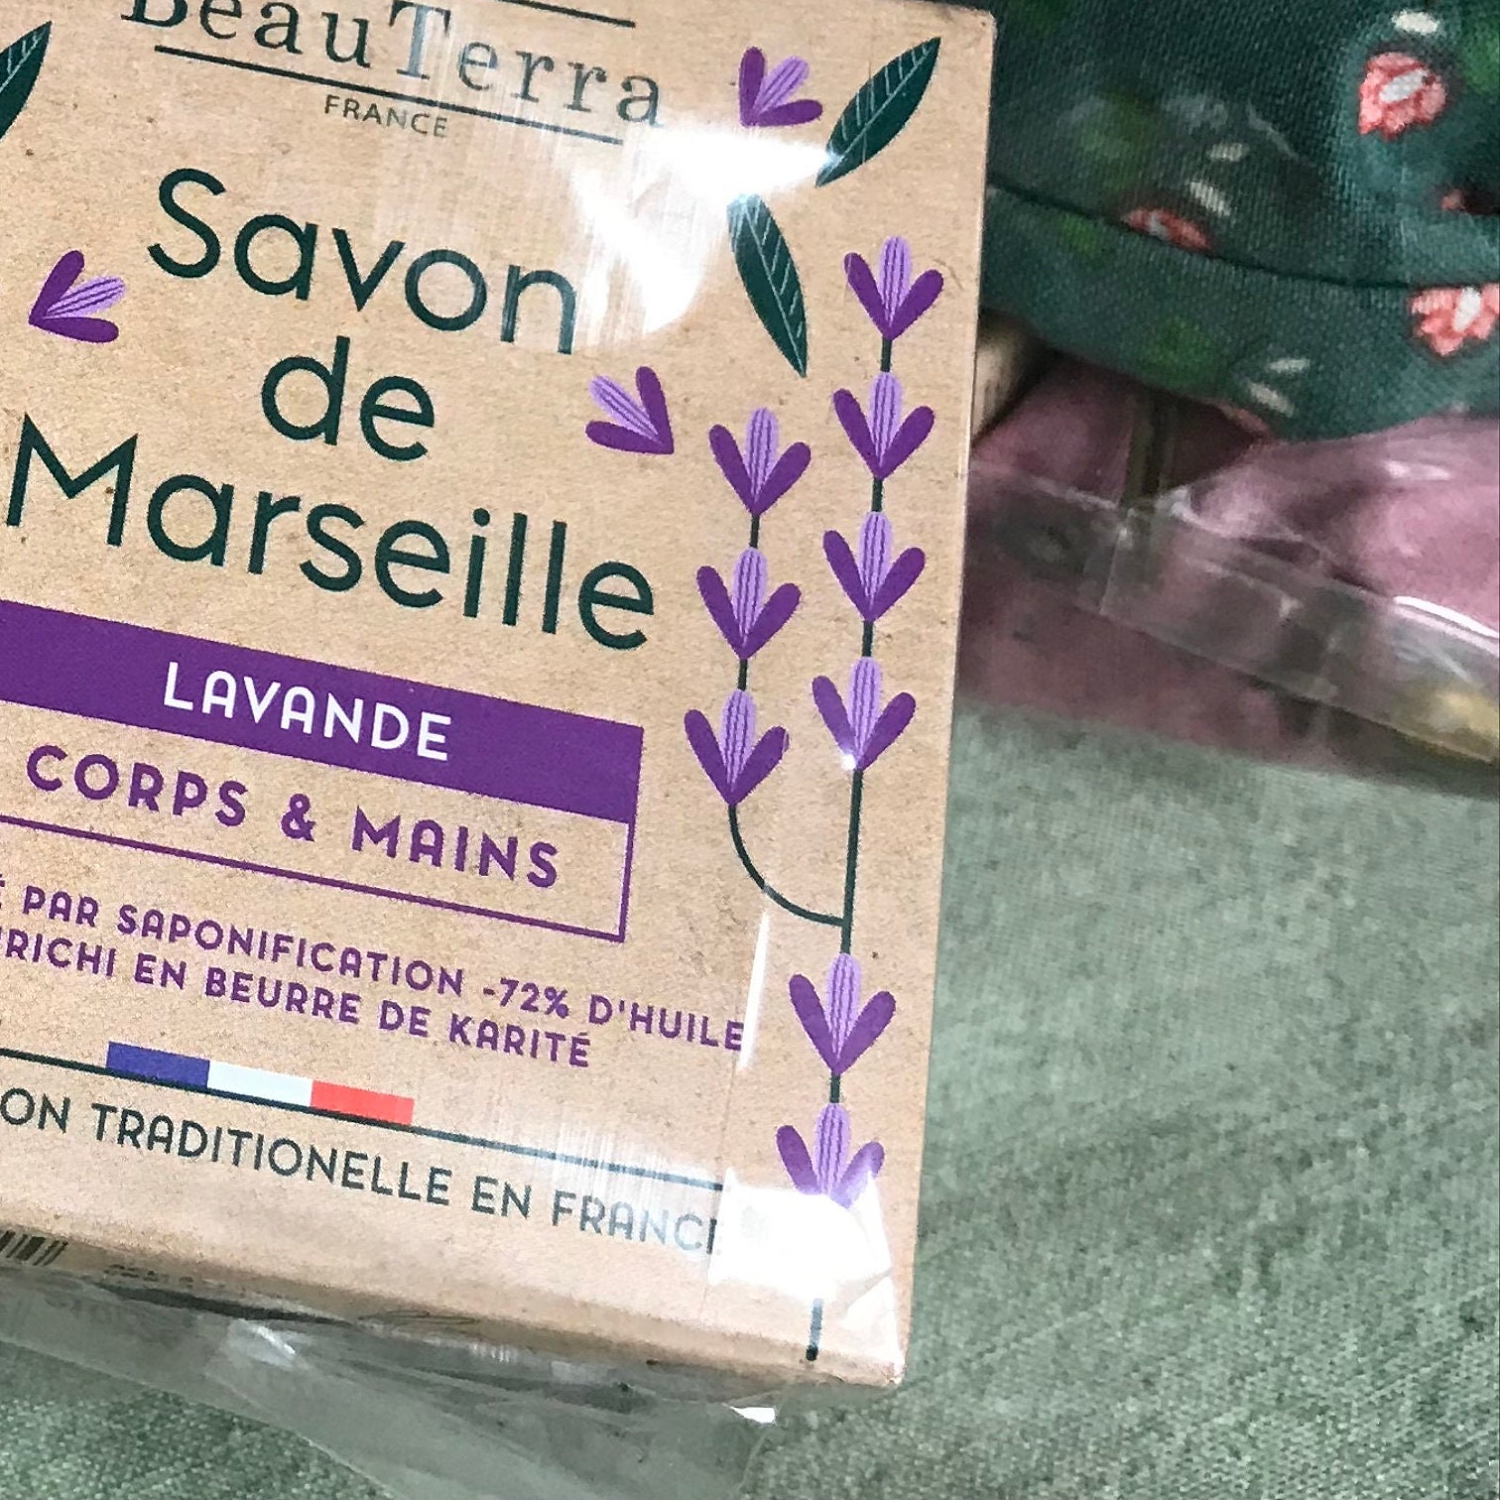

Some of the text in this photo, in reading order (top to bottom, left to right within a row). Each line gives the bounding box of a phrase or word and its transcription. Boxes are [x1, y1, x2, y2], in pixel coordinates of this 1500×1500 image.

[322, 94, 448, 138] FRANCE
[147, 167, 577, 355] Savon
[261, 335, 435, 461] de
[6, 412, 654, 650] Marseille
[163, 661, 452, 762] LAVANDE
[26, 744, 558, 889] CORPS & MAINS
[23, 886, 99, 927] PAR
[117, 904, 463, 997] SAPONIFICATION
[482, 977, 569, 1019] -72%
[589, 994, 744, 1052] D'HUILE
[135, 953, 187, 990] EN
[205, 967, 361, 1024] BEURRE
[379, 1000, 430, 1038] DE
[449, 1013, 591, 1068] KARITÉ
[91, 1102, 453, 1206] TRADITIONELLE
[471, 1176, 532, 1219] EN
